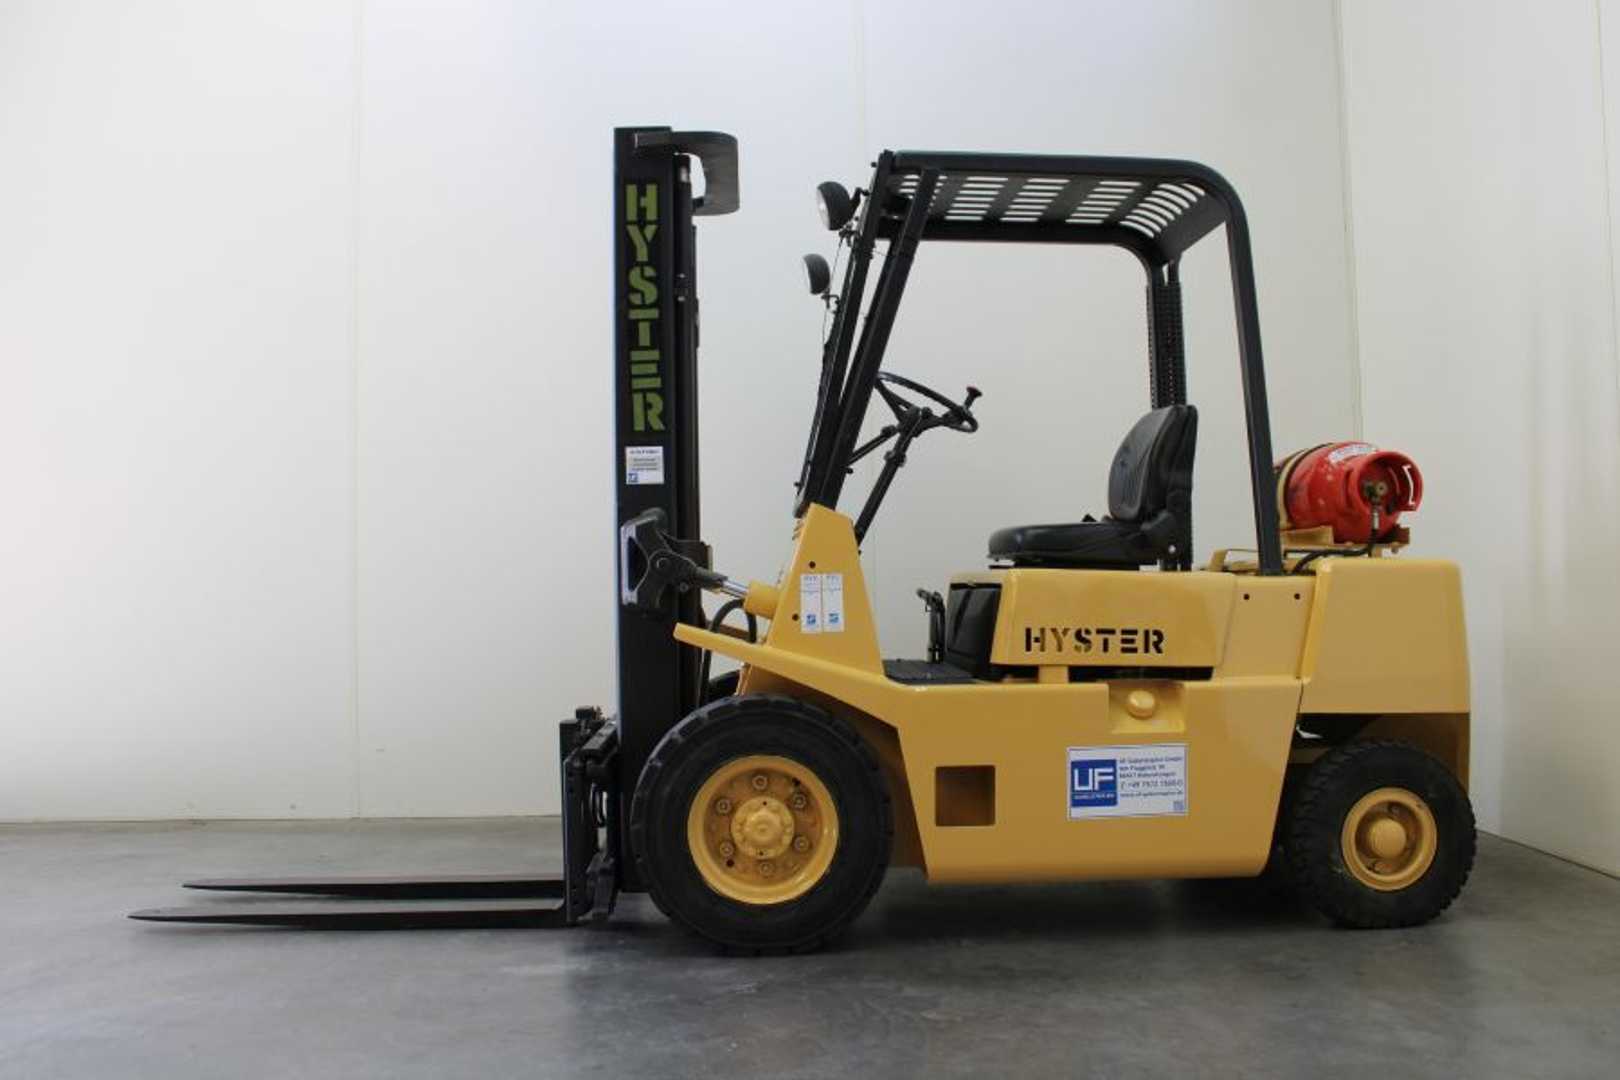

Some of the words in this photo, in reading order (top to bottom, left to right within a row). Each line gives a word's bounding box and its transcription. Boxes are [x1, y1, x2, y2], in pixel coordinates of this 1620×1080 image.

[625, 184, 666, 432] HYSTER
[1025, 627, 1165, 654] HYSTER
[1074, 768, 1114, 790] UF
